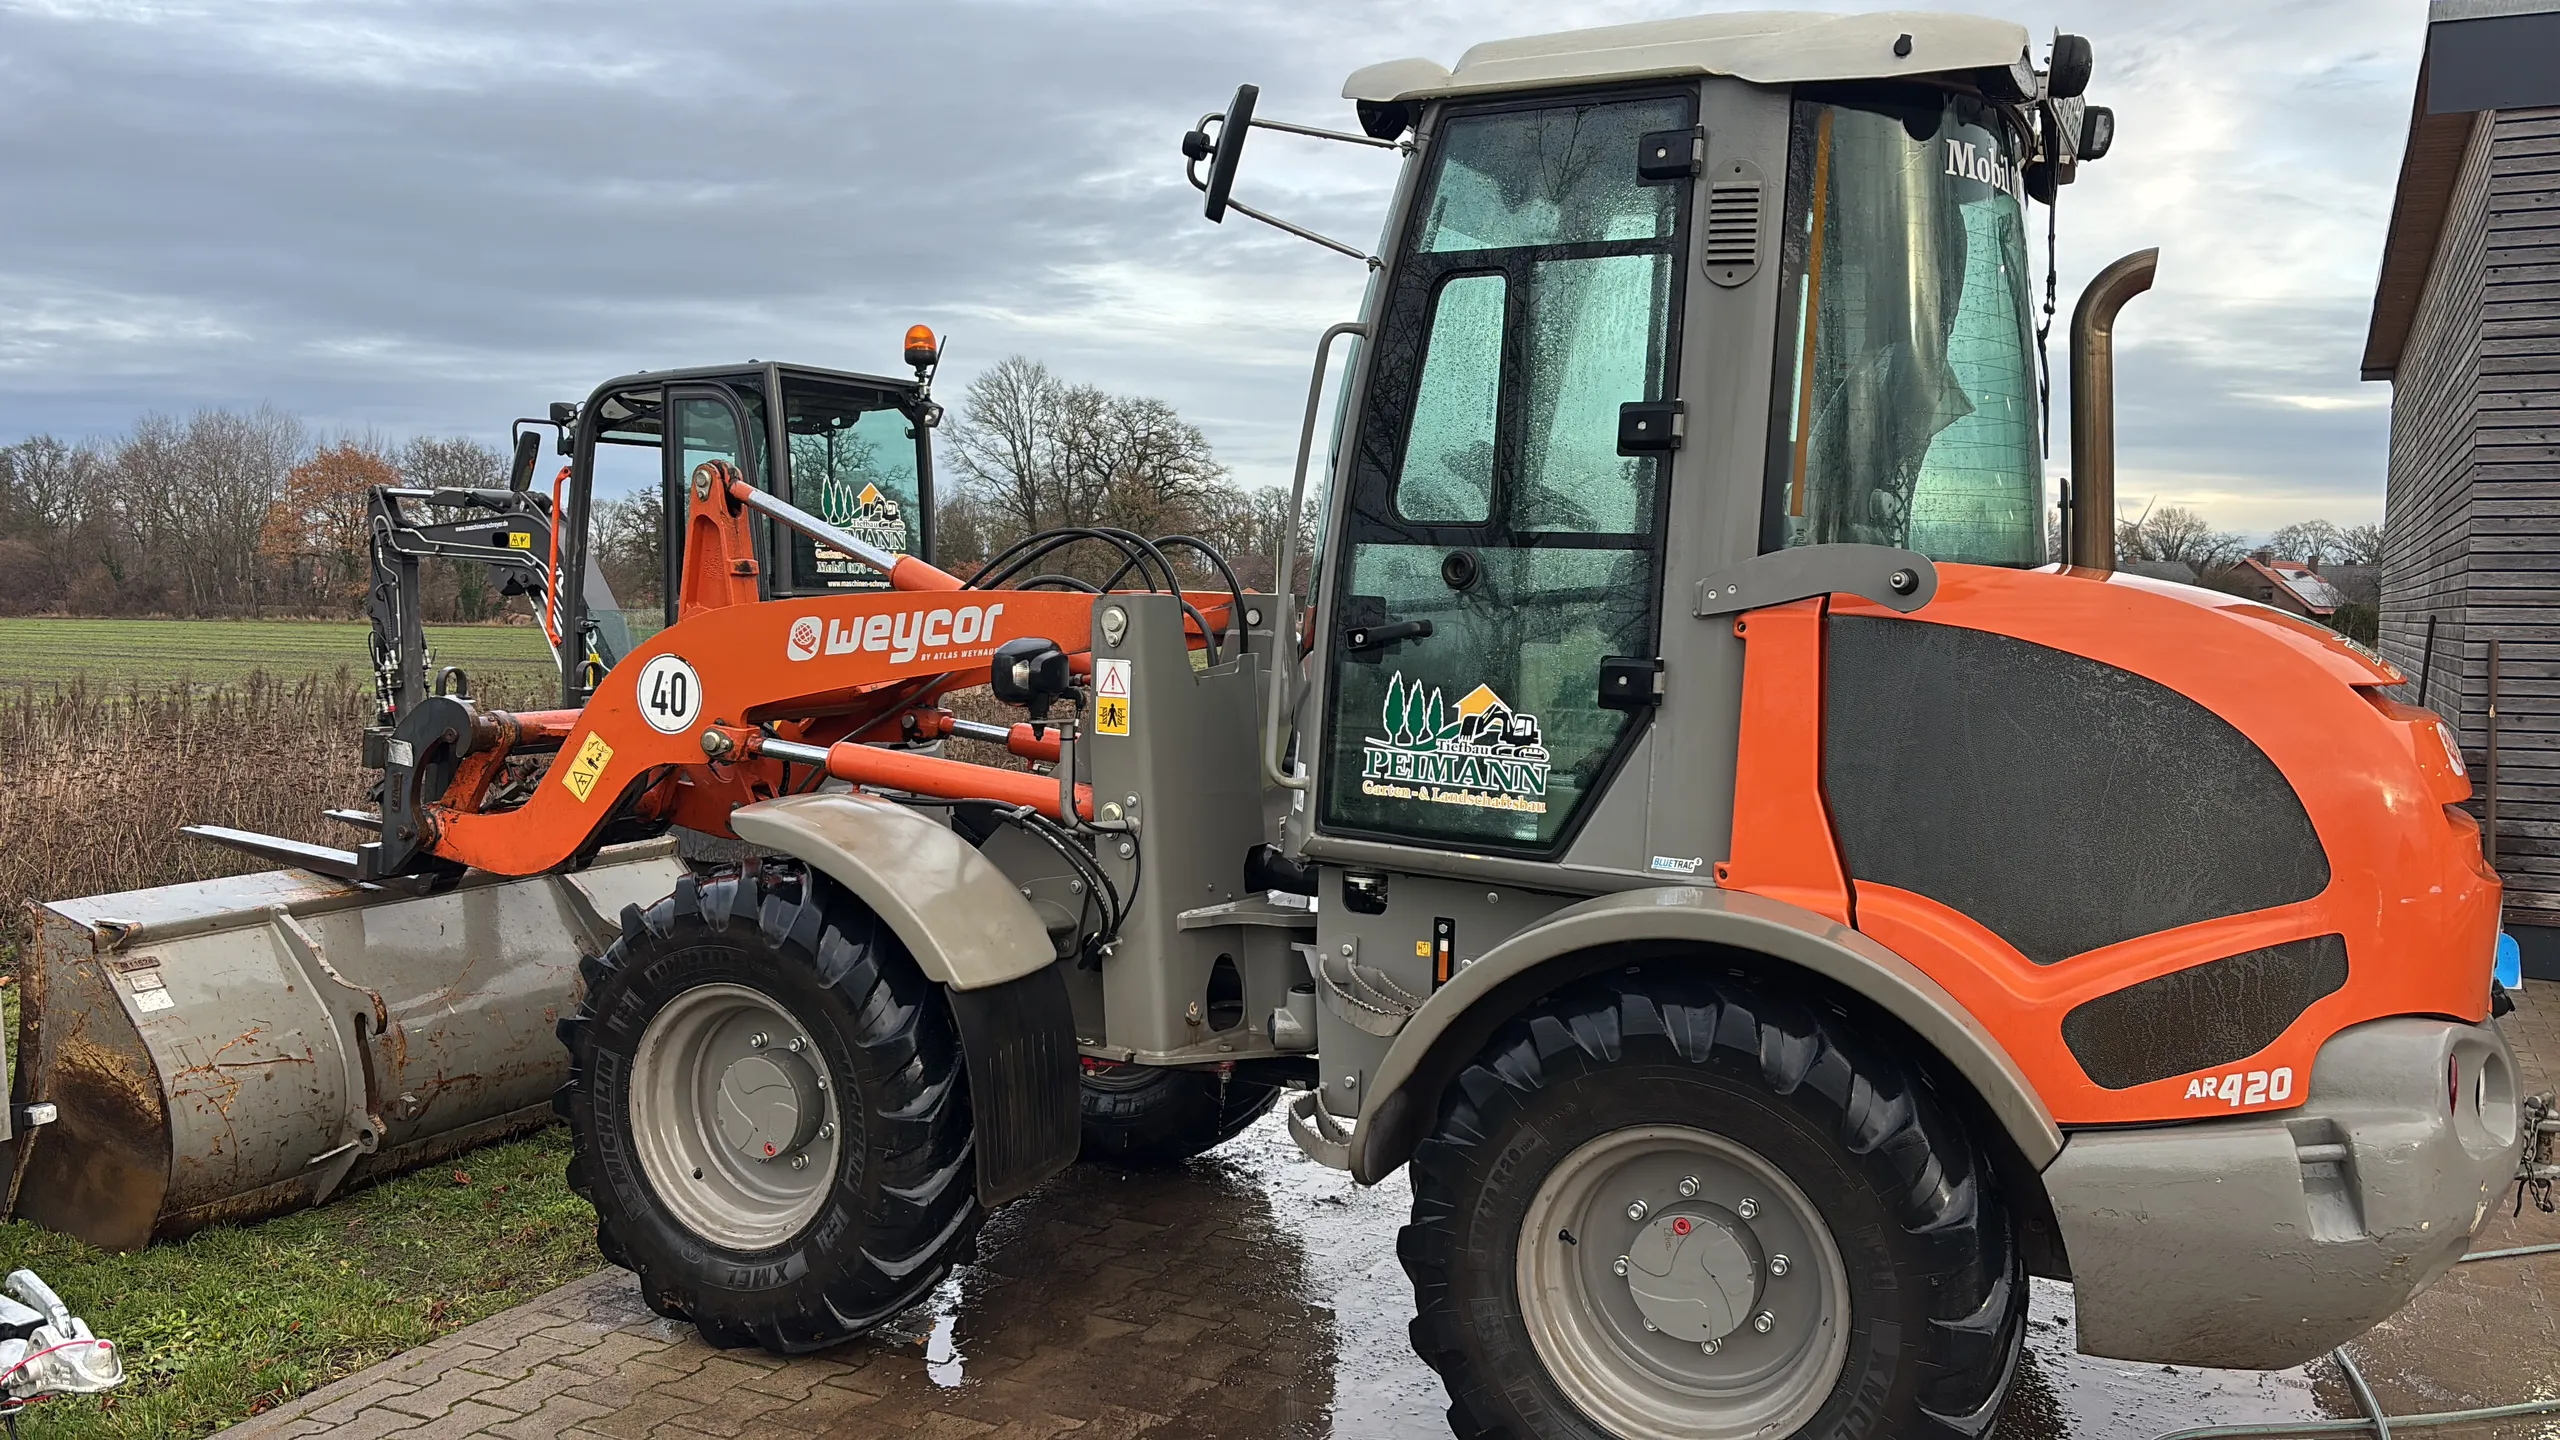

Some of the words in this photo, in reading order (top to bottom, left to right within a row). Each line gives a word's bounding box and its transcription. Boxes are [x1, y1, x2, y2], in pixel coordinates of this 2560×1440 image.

[1944, 138, 2011, 195] Mobil
[455, 520, 508, 532] www.maschinen-schreyer.de
[853, 519, 879, 528] Tiefbau
[816, 561, 847, 574] Mobil
[827, 580, 892, 589] www.maschinen-schreyer.
[825, 603, 1004, 664] weycor
[921, 653, 932, 661] BY
[933, 650, 958, 661] ATLAS
[961, 647, 999, 658] WEYHAUS
[650, 670, 686, 717] 40
[1438, 740, 1489, 755] Tiefbau
[1362, 747, 1551, 796] PEIMANN
[1431, 788, 1547, 814] Landschaftsbau
[594, 1053, 628, 1186] MICHELIN
